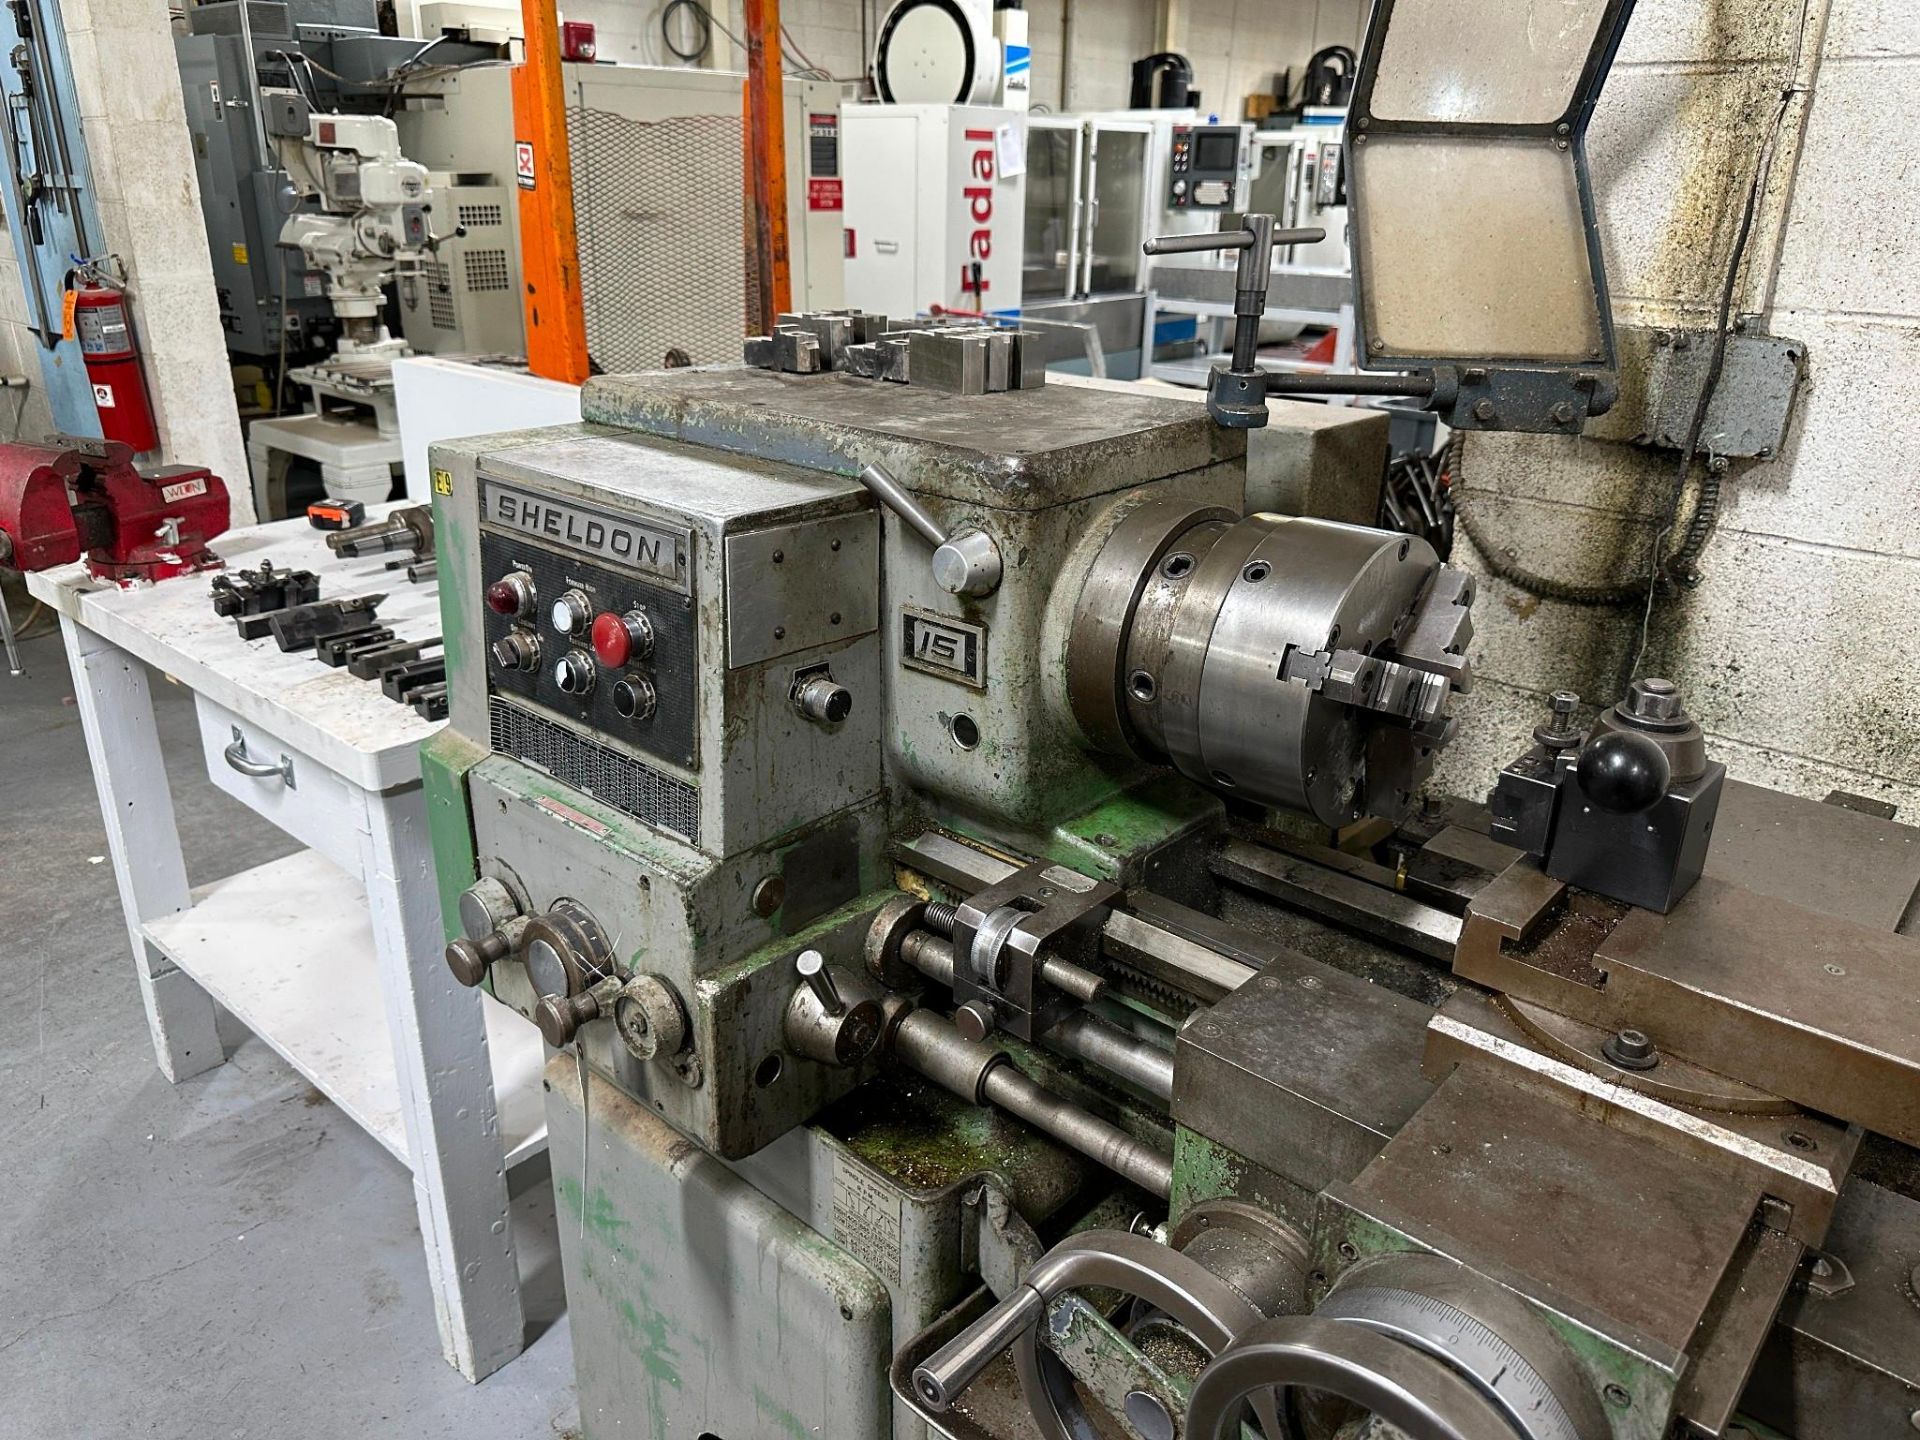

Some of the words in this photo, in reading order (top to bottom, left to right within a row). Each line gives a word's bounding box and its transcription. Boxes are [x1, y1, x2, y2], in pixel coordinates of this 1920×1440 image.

[961, 128, 995, 294] Fadal
[499, 494, 661, 566] SHELDON
[920, 631, 959, 661] 15
